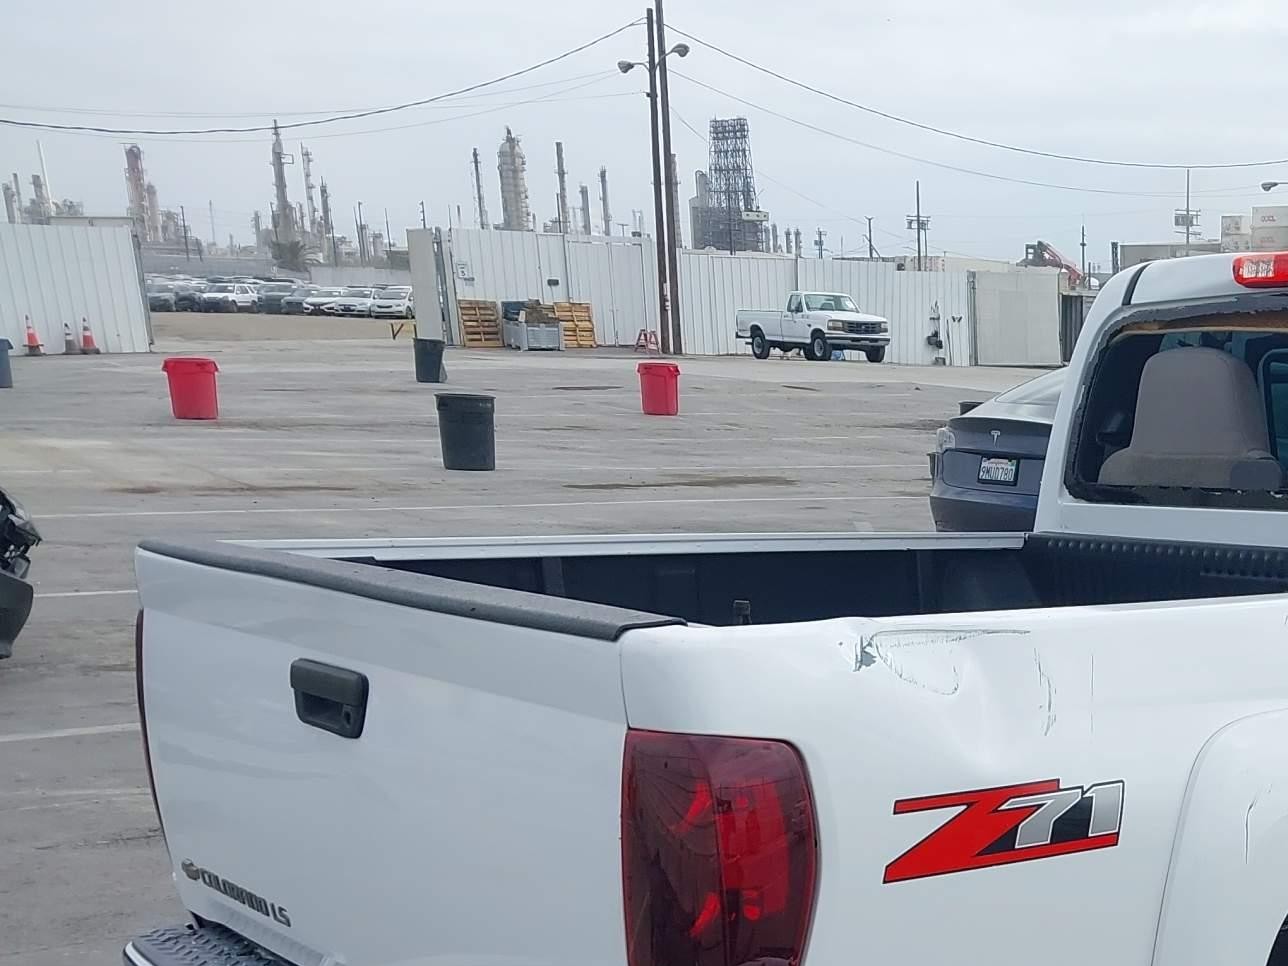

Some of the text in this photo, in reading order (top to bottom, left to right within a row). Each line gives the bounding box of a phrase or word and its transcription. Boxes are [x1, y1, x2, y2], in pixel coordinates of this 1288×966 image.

[882, 777, 1126, 884] Z71
[200, 867, 291, 927] COLORADO LS
